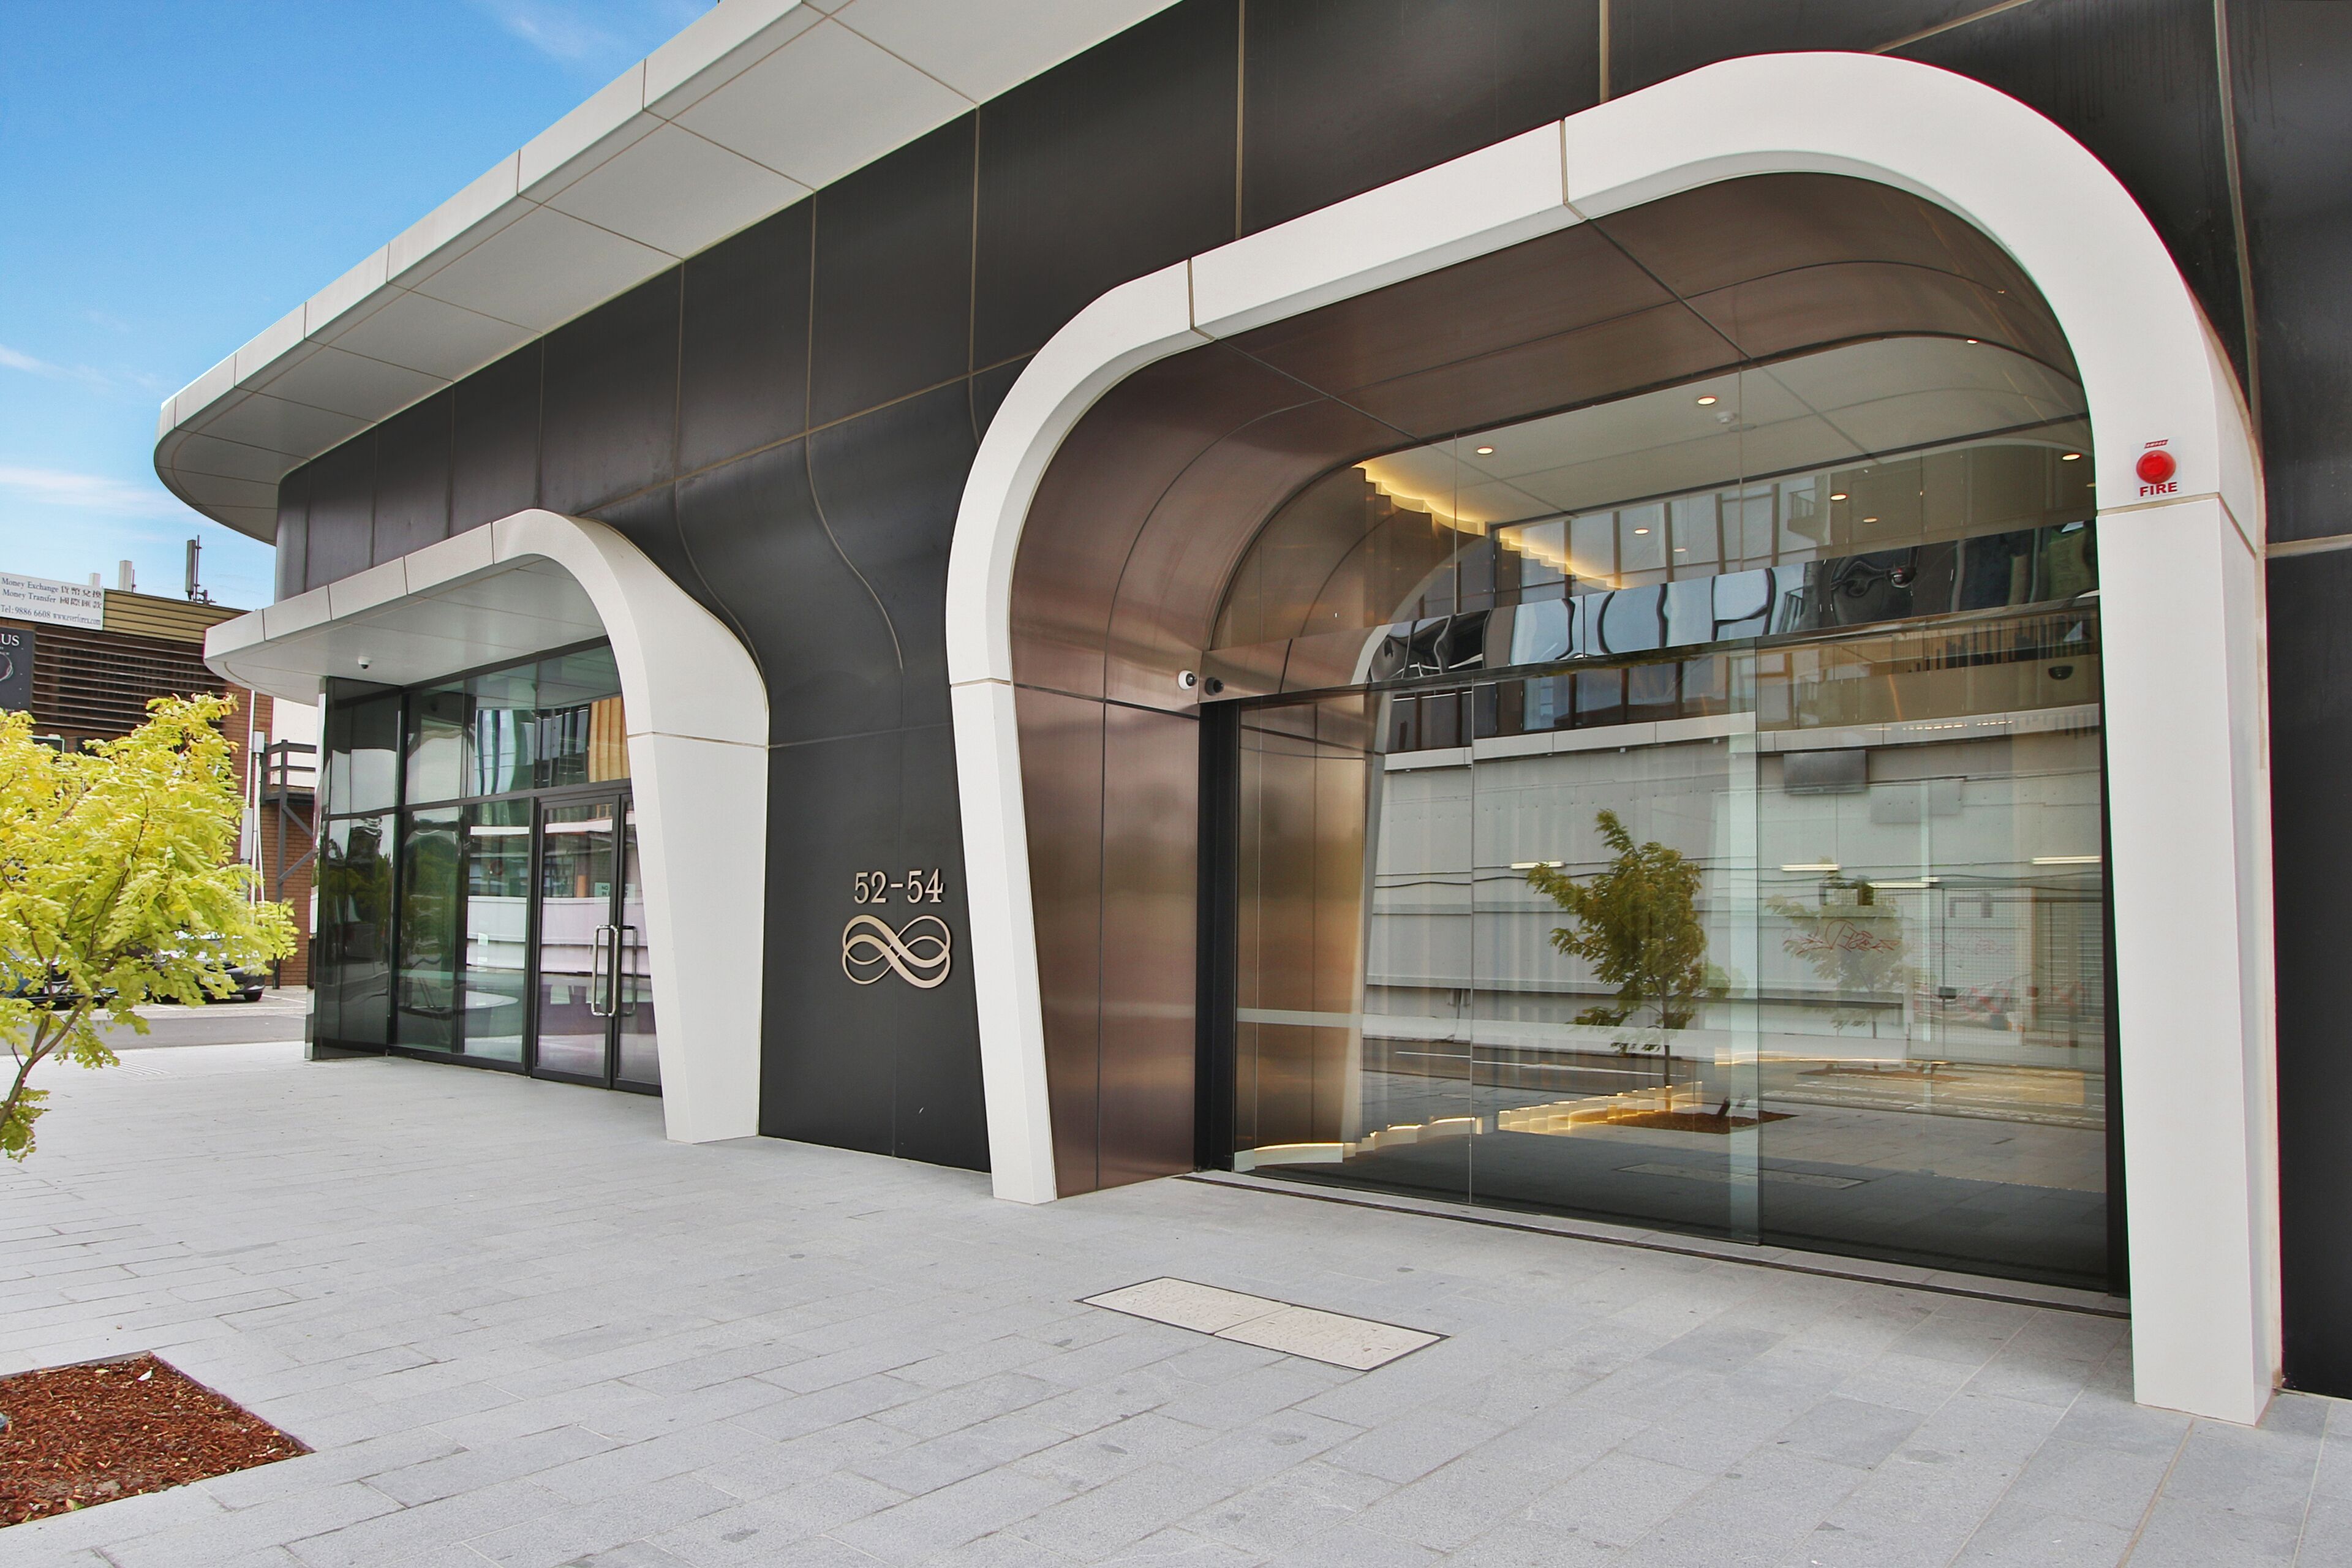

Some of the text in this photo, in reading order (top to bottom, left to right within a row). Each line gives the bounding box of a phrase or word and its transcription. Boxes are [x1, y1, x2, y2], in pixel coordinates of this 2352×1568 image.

[2139, 481, 2178, 497] FIRE
[1, 578, 59, 593] Money Exchange
[2, 589, 56, 603] Money Transfer
[34, 609, 51, 619] 6608
[0, 633, 20, 647] US
[854, 868, 944, 905] 52-54
